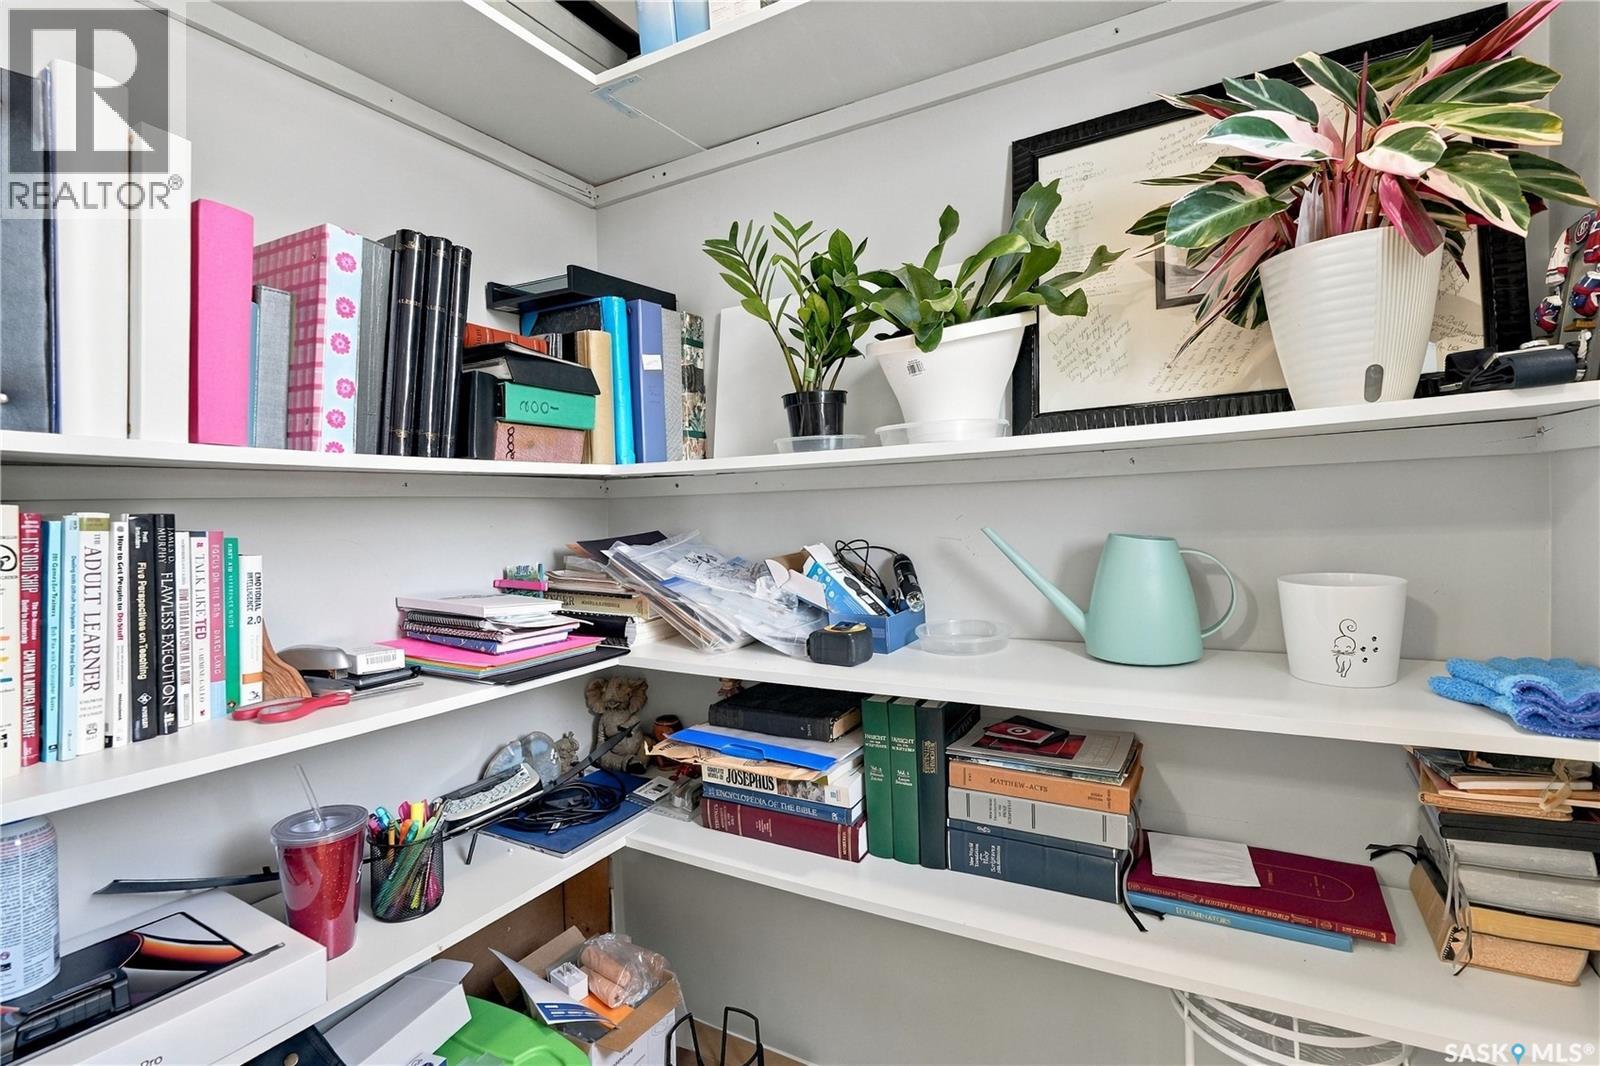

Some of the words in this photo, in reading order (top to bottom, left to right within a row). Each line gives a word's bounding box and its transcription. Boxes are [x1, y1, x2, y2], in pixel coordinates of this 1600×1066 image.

[21, 537, 39, 553] IT'S
[117, 553, 124, 561] to
[158, 528, 166, 564] MURPHY
[212, 544, 220, 570] FOCUS
[21, 555, 39, 572] OUR
[83, 546, 102, 605] ADULT
[137, 562, 147, 579] Five
[194, 554, 206, 585] TALK
[21, 574, 39, 593] SHIP
[136, 580, 148, 631] Perspectives
[160, 572, 174, 630] FLAWLESS
[195, 588, 206, 617] LIKE
[116, 612, 124, 622] Do
[195, 618, 207, 640] TED
[247, 616, 262, 625] 2.0
[138, 632, 146, 643] on
[82, 611, 101, 694] LEARNER
[137, 644, 148, 680] Teaching
[162, 634, 175, 706] EXECUTION
[726, 768, 774, 791] JOSEPHUS
[715, 788, 767, 806] ENCYCLOPEDIA
[768, 800, 780, 808] OF
[780, 802, 796, 812] THE
[796, 806, 818, 817] BIBLE
[1267, 909, 1290, 921] WORLD
